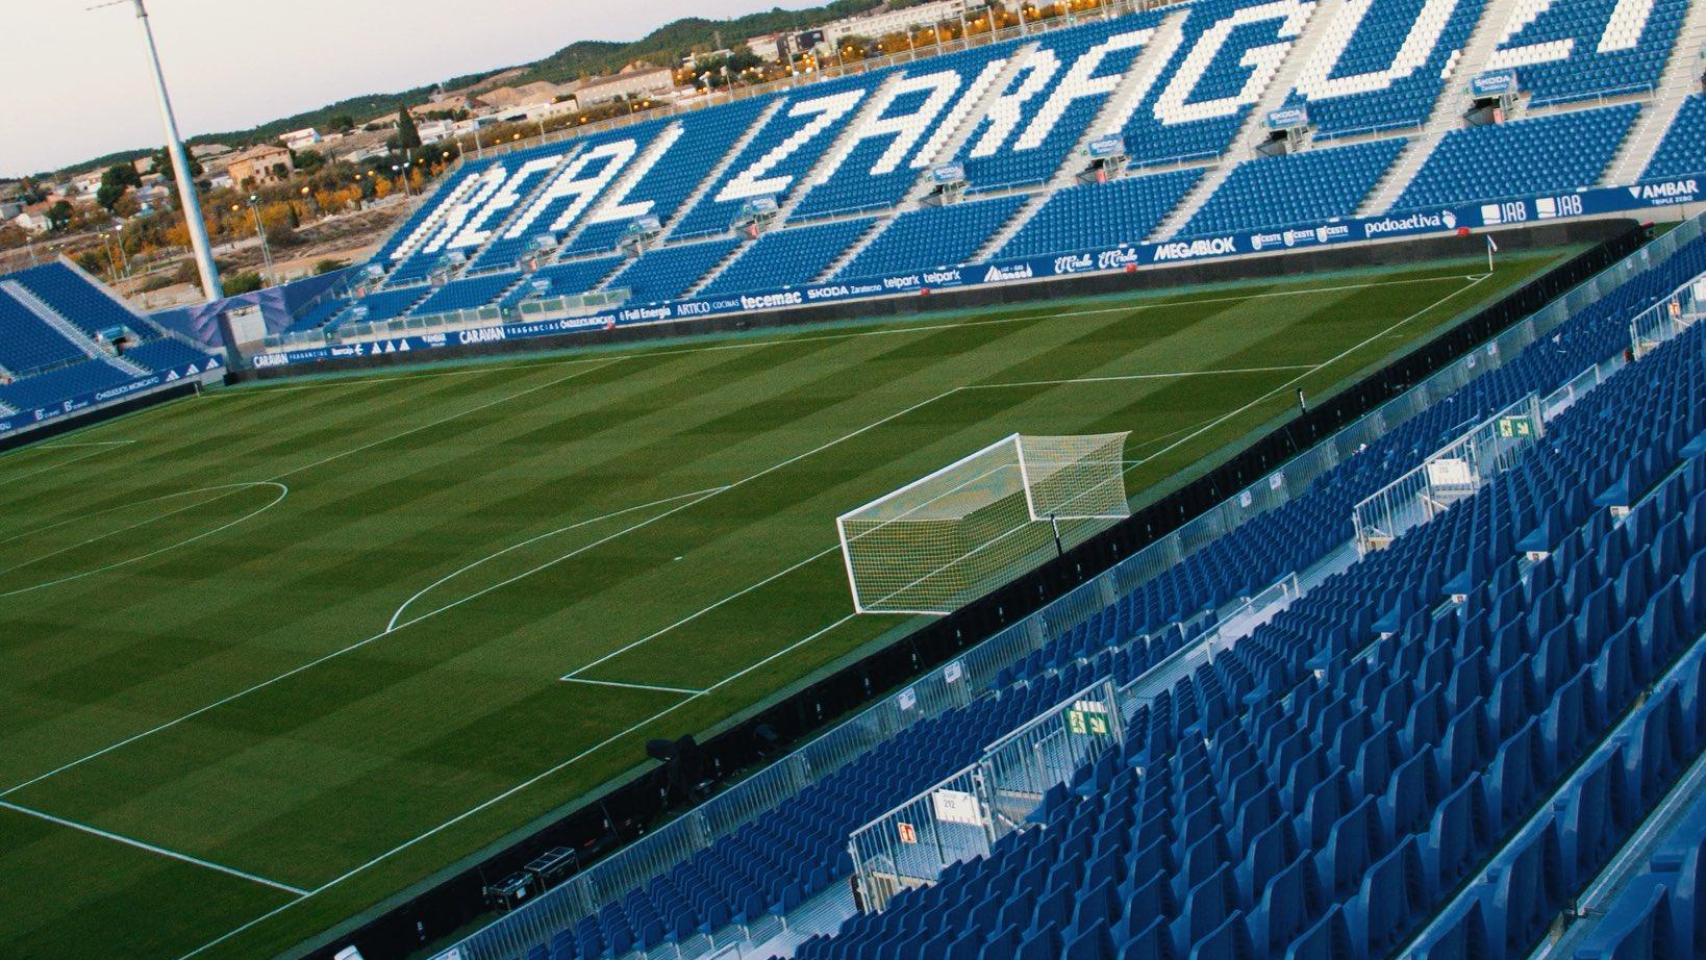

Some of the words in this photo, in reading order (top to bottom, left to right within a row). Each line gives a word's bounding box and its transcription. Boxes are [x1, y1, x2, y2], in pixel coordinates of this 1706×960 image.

[388, 123, 681, 259] REAL
[1642, 179, 1699, 199] AMBAR
[1501, 201, 1527, 224] JAB
[1556, 195, 1583, 217] JAB
[1364, 213, 1441, 238] podoactiva
[1153, 236, 1236, 261] MEGABLOK
[883, 275, 921, 290] telpark
[922, 269, 961, 285] telpark
[740, 291, 803, 310] tecemac
[459, 326, 506, 345] CARAVAN
[252, 352, 289, 369] CARAVAN
